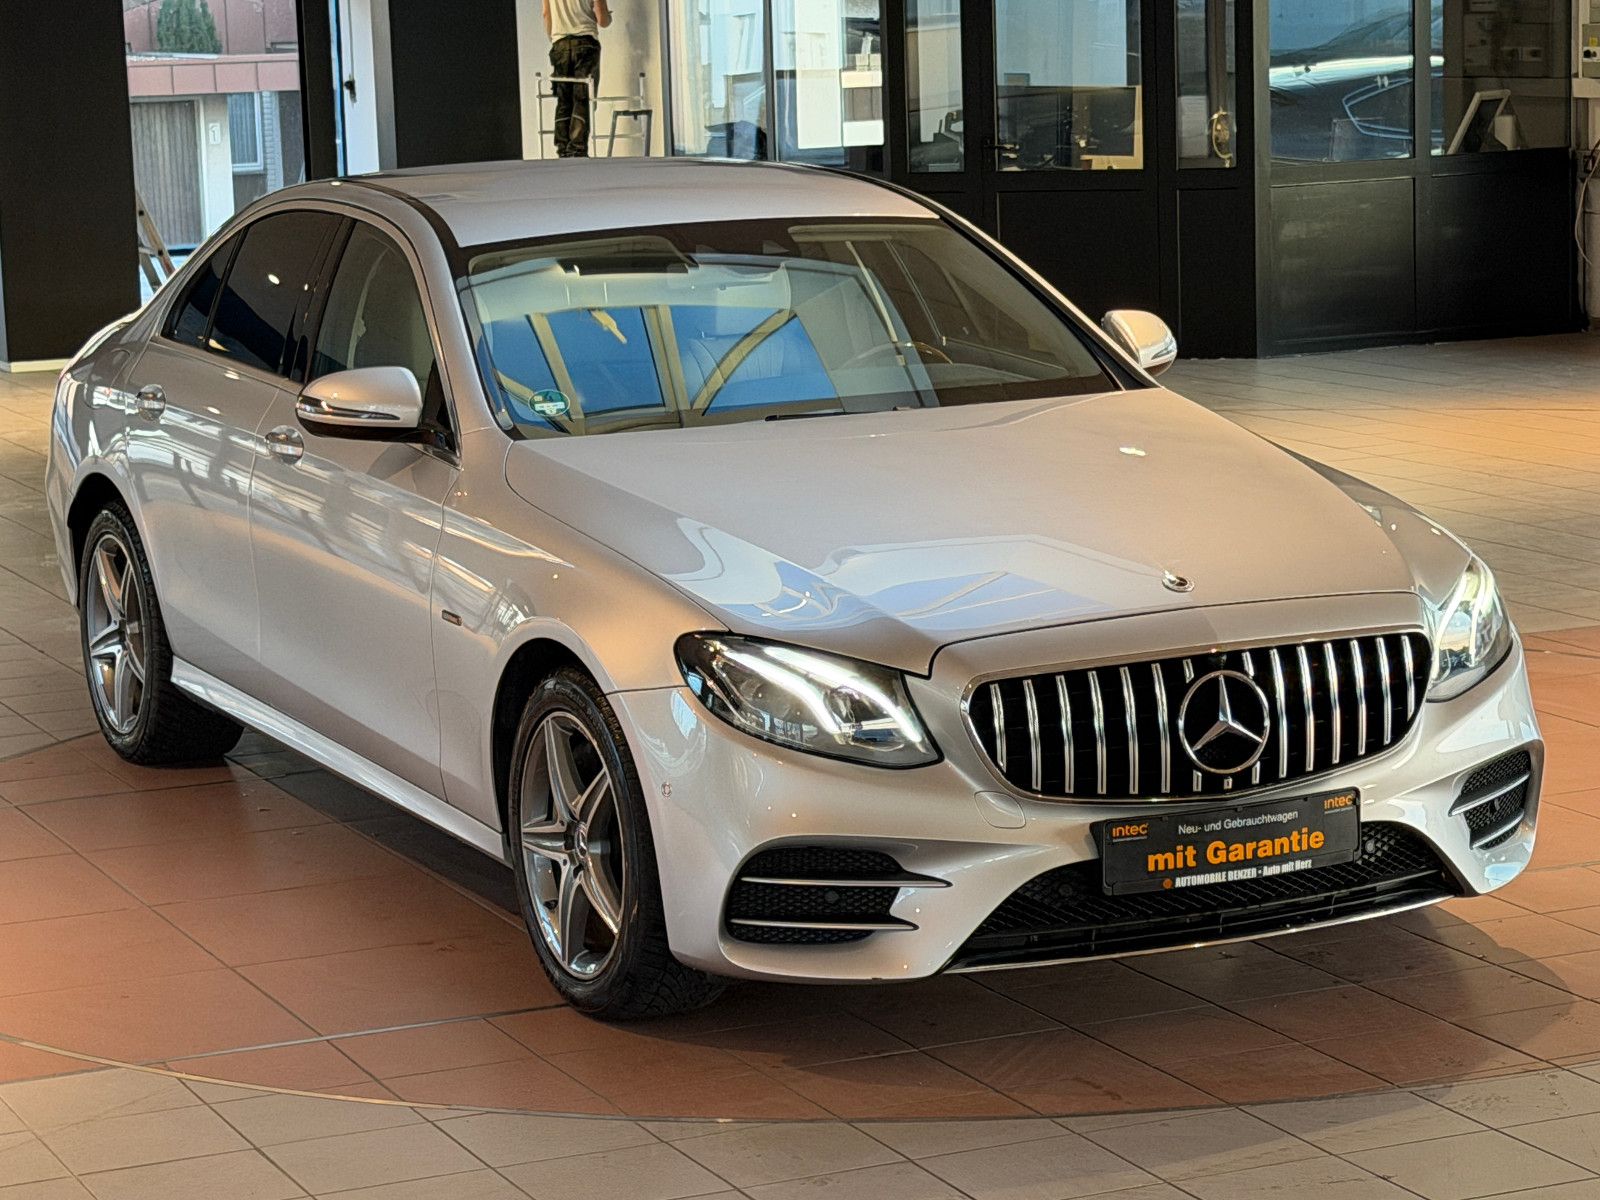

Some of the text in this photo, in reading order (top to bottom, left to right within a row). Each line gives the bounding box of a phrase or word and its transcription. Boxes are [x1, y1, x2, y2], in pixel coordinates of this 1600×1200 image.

[1323, 794, 1353, 809] intec
[1112, 822, 1148, 837] intec
[1178, 810, 1299, 835] Neu- und Gebrauchtwagen
[1147, 827, 1325, 872] mit Garantie
[1174, 871, 1227, 888] AUTOMOBILE
[1262, 865, 1280, 877] Auto
[1281, 861, 1295, 873] mit
